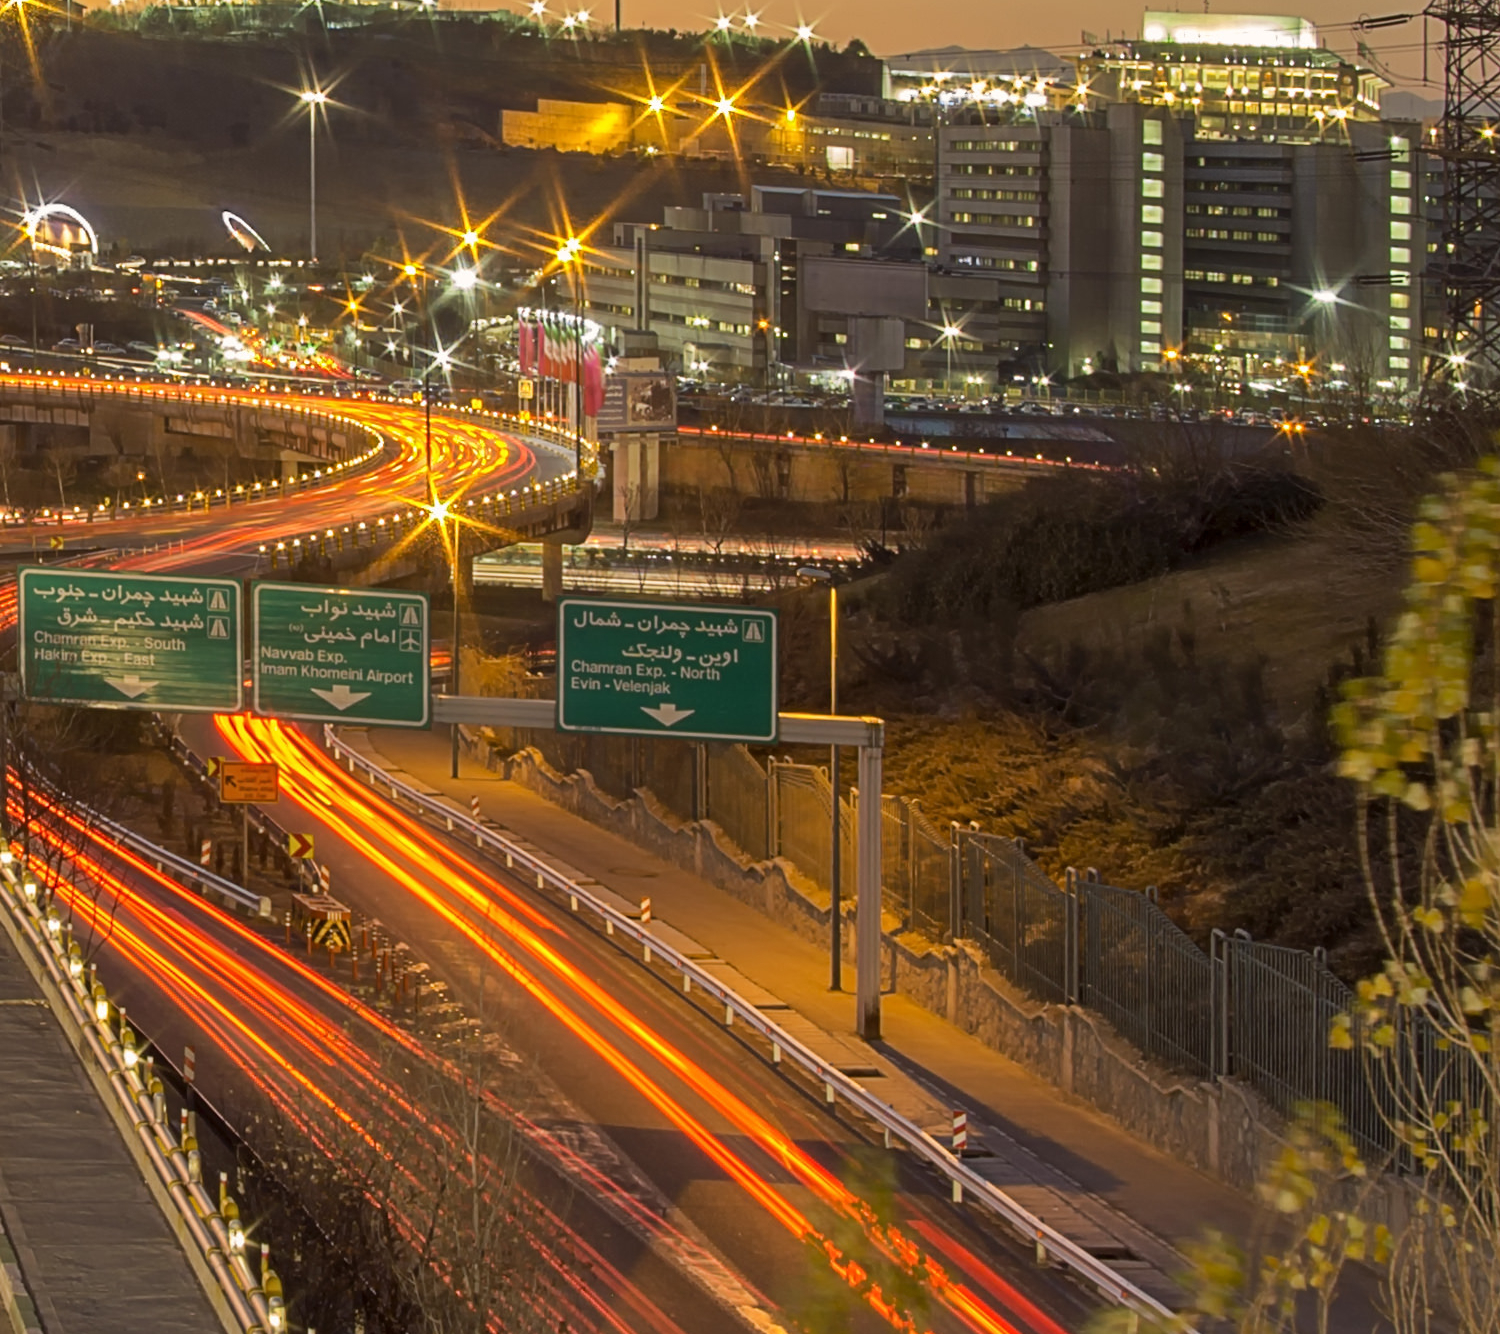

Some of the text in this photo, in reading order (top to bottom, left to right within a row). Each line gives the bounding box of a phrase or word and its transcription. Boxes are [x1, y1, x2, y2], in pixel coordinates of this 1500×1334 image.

[33, 584, 85, 603] جنوب
[102, 585, 155, 608] چمران
[160, 588, 204, 606] شهید
[57, 607, 98, 628] شرق
[301, 599, 397, 621] شهید نواب
[573, 611, 622, 628] شمال
[114, 611, 155, 633] حکیم
[160, 613, 204, 633] شهید
[637, 615, 690, 638] چمران
[695, 618, 738, 637] شهید
[34, 630, 97, 647] Chamran
[100, 634, 130, 649] Exp.
[144, 637, 186, 651] South
[304, 625, 356, 644] خمینی
[361, 629, 397, 649] امام
[34, 648, 78, 662] Hakim
[81, 650, 111, 665] Exp.
[124, 652, 156, 666] East
[261, 646, 348, 664] Navvab Exp.
[621, 643, 682, 664] ولنجک
[699, 649, 739, 666] اوین
[261, 662, 414, 685] Imam Khomeini Airport
[571, 660, 632, 676] Chamran
[636, 663, 666, 678] Exp.
[680, 666, 721, 681] North
[571, 677, 601, 690] Evin
[613, 679, 671, 696] Velenjak
